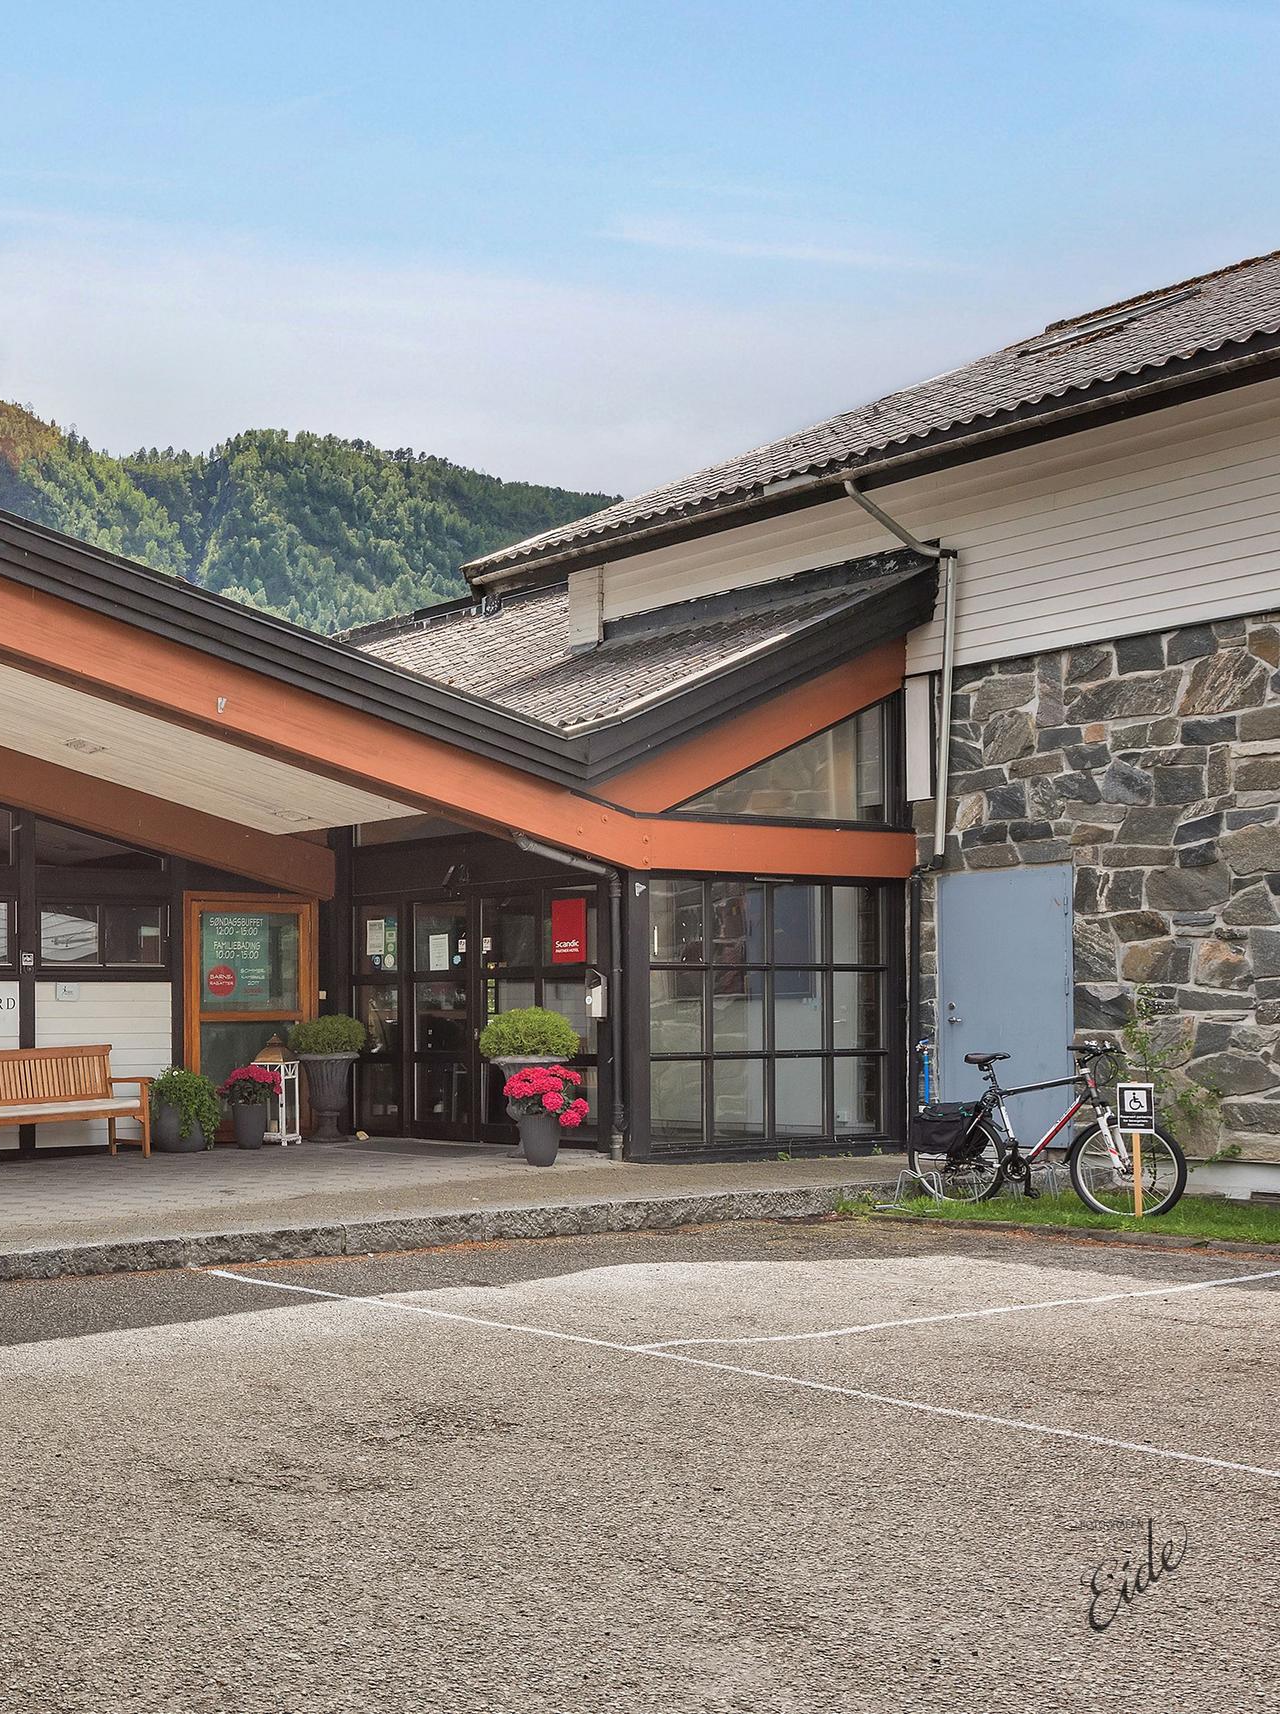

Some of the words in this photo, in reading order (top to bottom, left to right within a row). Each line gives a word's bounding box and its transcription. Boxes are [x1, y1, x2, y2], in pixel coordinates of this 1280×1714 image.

[209, 917, 264, 927] SØNDAGSBUFFET
[215, 927, 235, 936] 12:00
[240, 927, 258, 936] 15:00
[213, 941, 261, 950] FAMILIEBADING
[555, 939, 580, 948] Scandic
[215, 951, 235, 959] 10:00
[241, 951, 259, 960] 15:00
